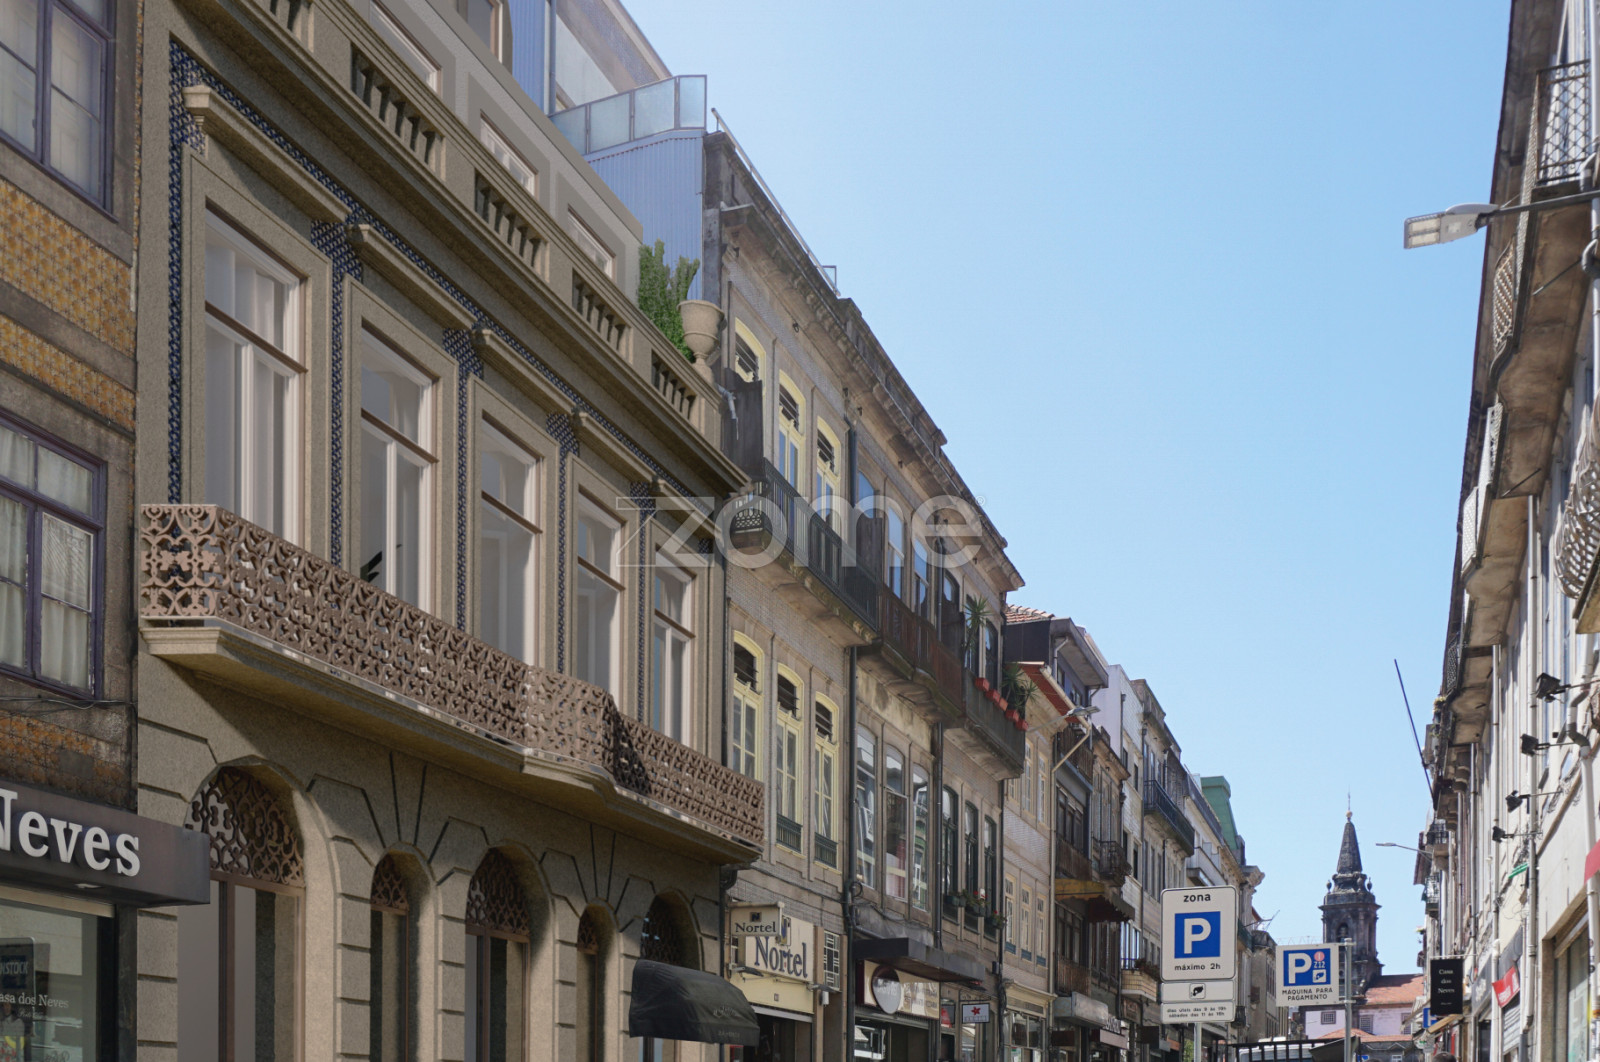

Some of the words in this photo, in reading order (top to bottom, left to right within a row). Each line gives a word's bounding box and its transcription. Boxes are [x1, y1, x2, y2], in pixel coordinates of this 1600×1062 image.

[1183, 893, 1211, 903] zona
[735, 921, 777, 933] Nortel
[1184, 917, 1212, 954] P
[754, 935, 808, 979] Nortel
[1210, 962, 1221, 970] 2h
[1288, 952, 1312, 984] P
[18, 992, 36, 1005] dos
[38, 995, 70, 1010] Neves
